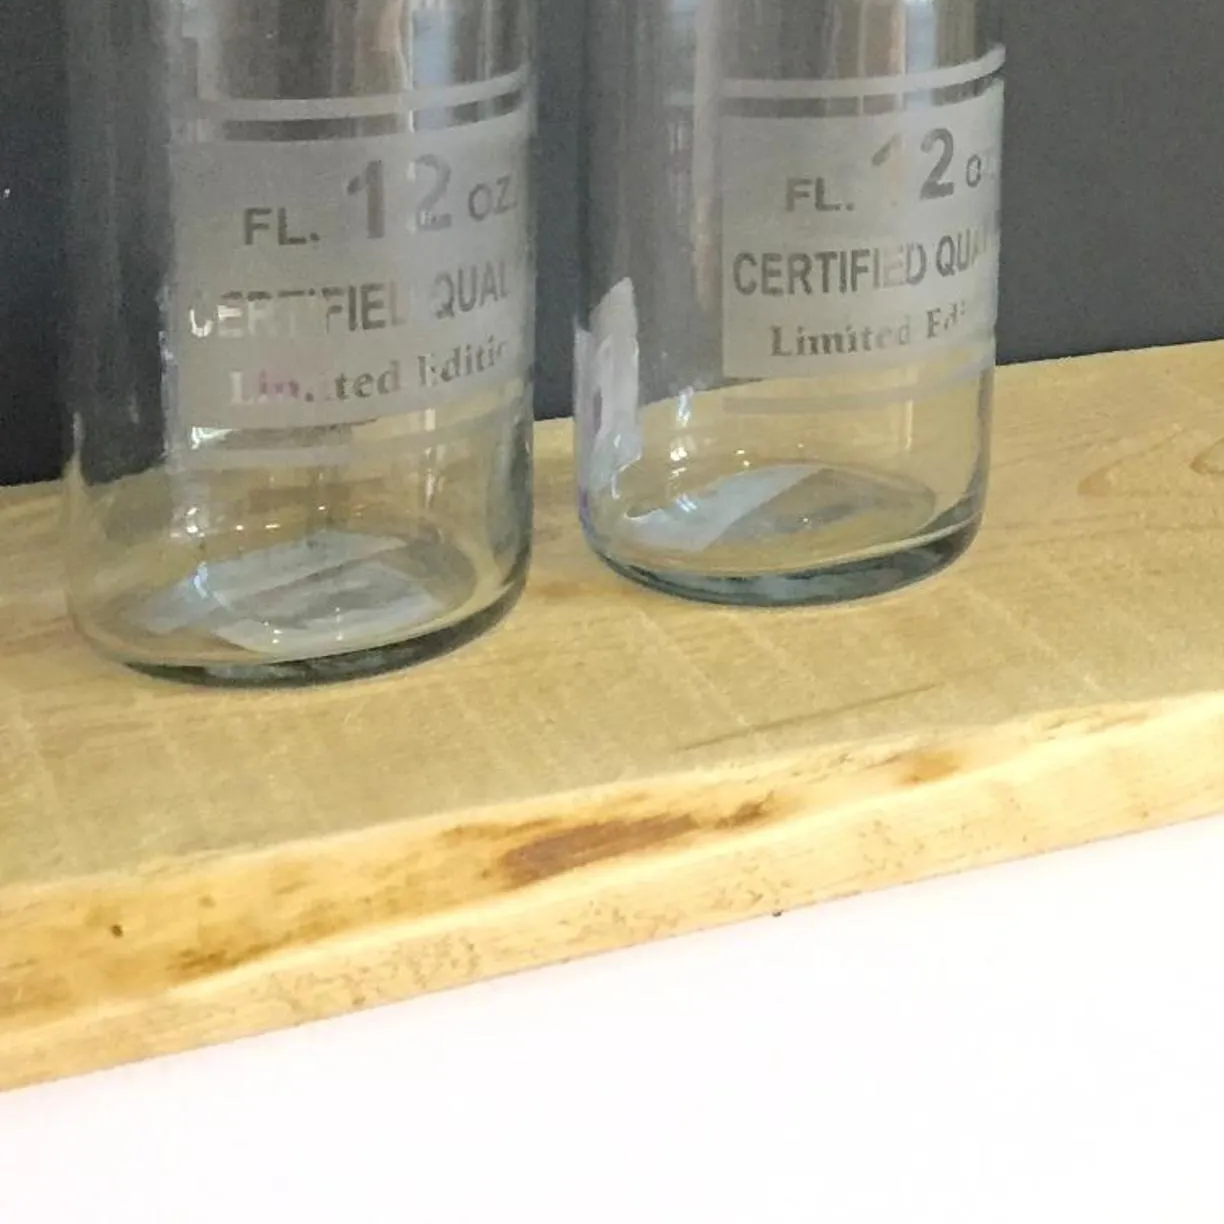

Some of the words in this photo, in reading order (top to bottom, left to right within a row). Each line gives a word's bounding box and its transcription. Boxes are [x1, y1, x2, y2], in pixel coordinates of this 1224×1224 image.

[243, 207, 320, 246] FL.
[347, 154, 453, 240] 12
[783, 177, 855, 212] FL.
[431, 260, 511, 320] QUAL
[732, 243, 927, 296] CERTIFIED
